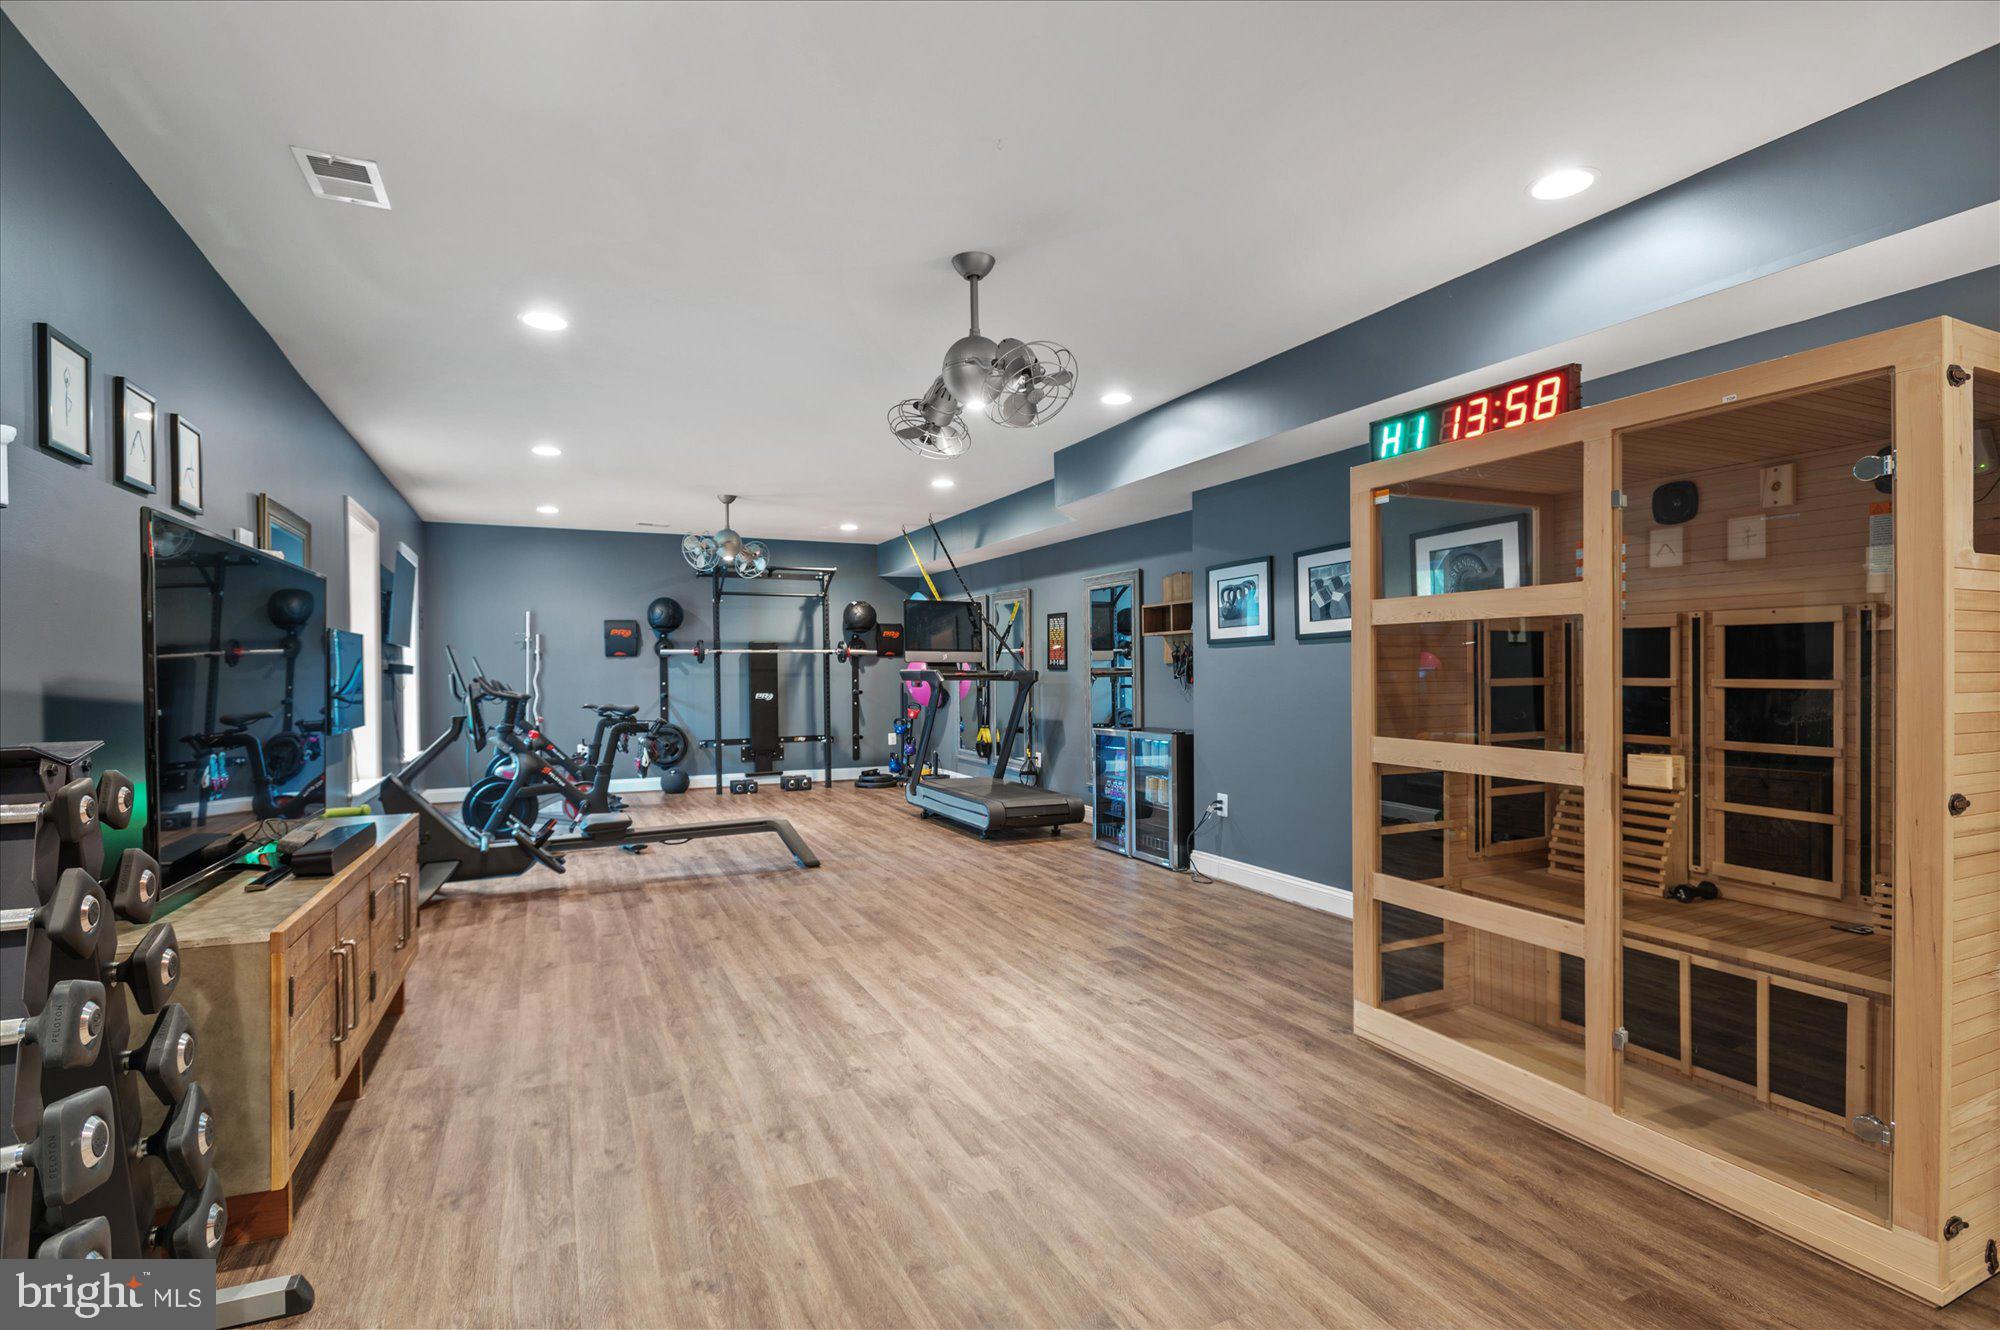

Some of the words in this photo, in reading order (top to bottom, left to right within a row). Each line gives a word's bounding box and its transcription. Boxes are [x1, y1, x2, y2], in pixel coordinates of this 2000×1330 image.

[1451, 375, 1562, 441] 13:58
[51, 1004, 63, 1043] PELOTON
[48, 1135, 57, 1179] PELOTON
